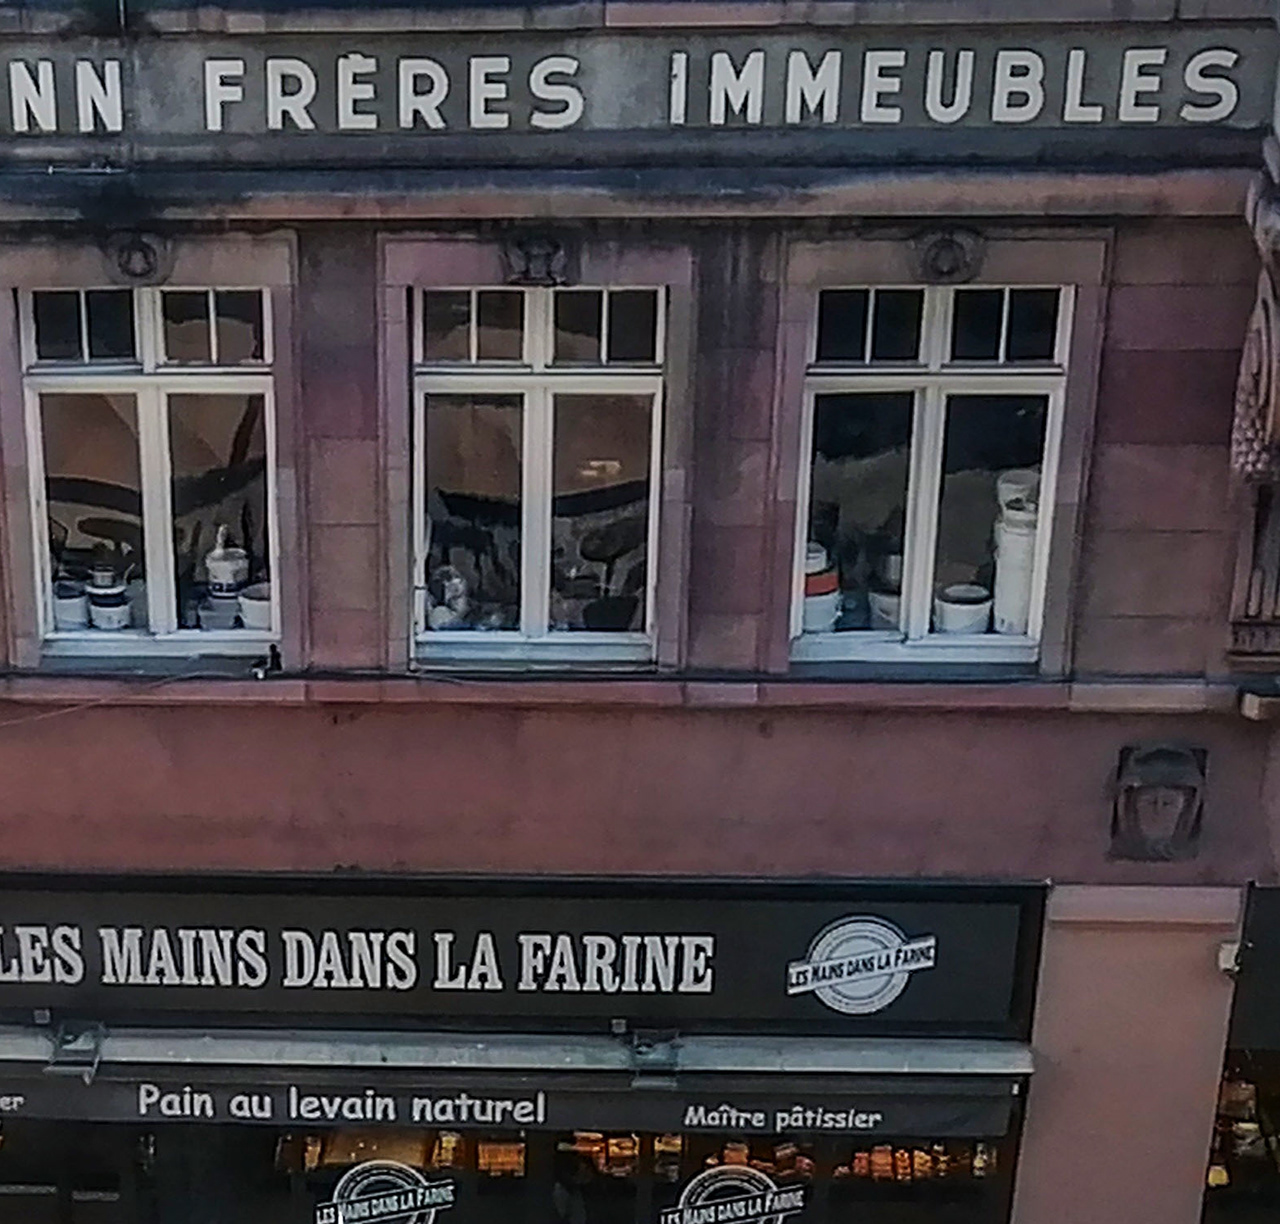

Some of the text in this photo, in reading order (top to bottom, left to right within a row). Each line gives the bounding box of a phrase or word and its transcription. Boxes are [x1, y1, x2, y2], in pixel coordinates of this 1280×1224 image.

[669, 49, 1240, 125] IMMEUBLES
[99, 927, 268, 987] MAINS
[282, 930, 417, 989] DANS
[433, 932, 503, 991] LA
[517, 934, 715, 993] FARINE
[876, 952, 892, 970] LA
[137, 1083, 547, 1124] Pain au levain naturel
[683, 1104, 883, 1133] Maître pâtissier
[399, 1191, 415, 1210] LA
[747, 1197, 763, 1216] LA
